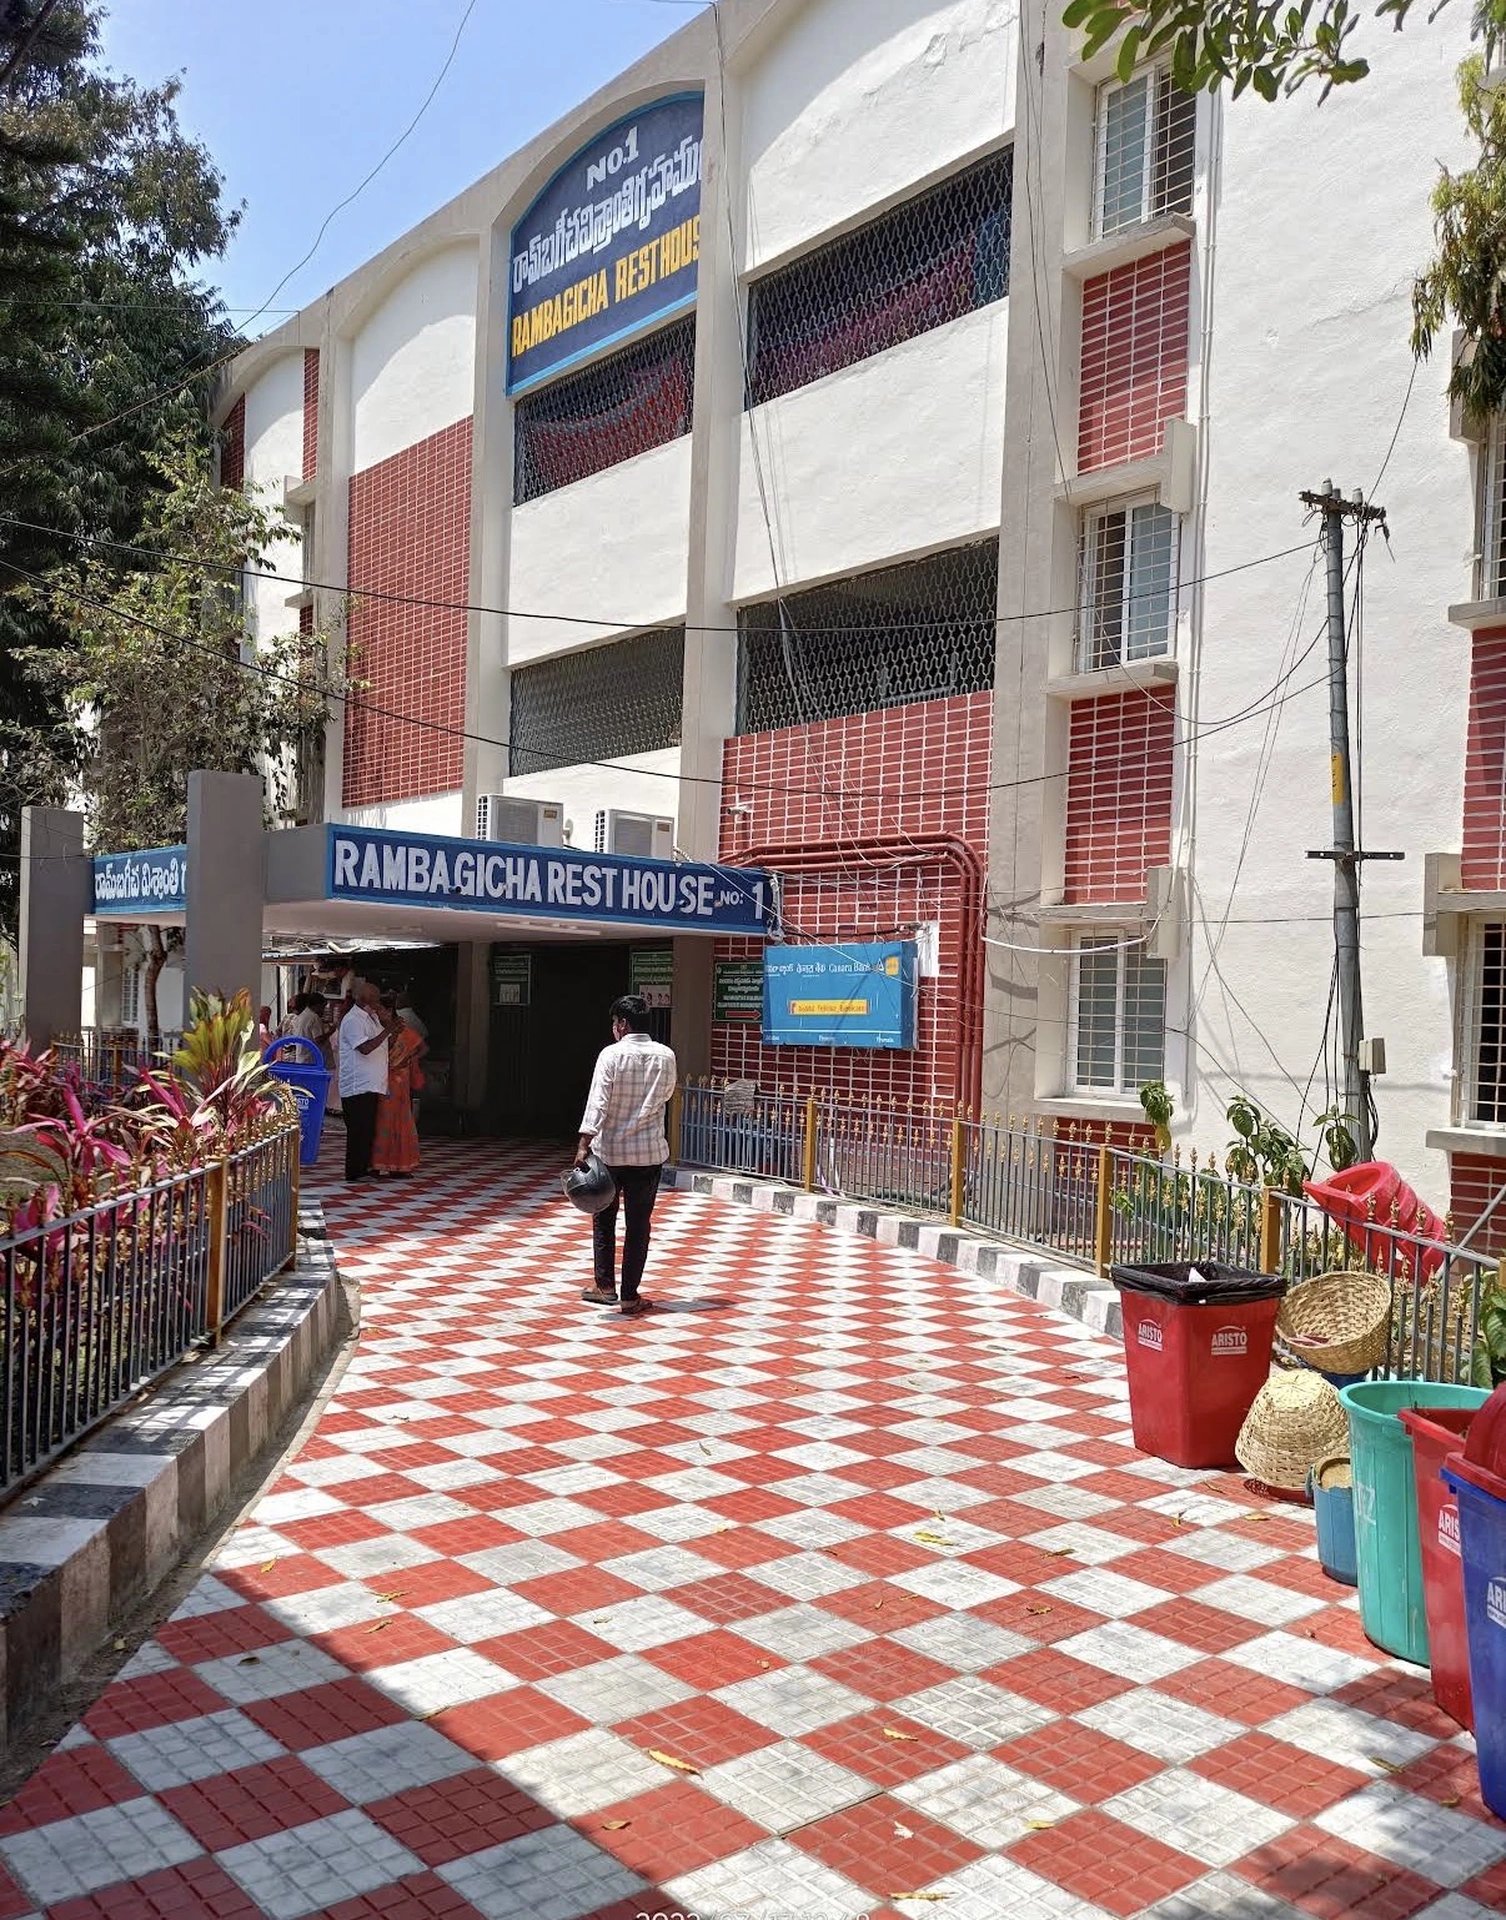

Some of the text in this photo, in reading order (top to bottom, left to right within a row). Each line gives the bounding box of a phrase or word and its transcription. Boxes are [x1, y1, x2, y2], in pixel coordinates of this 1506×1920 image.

[586, 126, 639, 191] NO.1
[511, 268, 608, 358] RAMBAGICHA
[334, 840, 542, 903] RAMBAGICHA
[548, 861, 617, 908] REST
[622, 868, 715, 916] HOUSE
[752, 882, 764, 920] 1
[1138, 1323, 1163, 1343] ARISTO
[1211, 1332, 1248, 1347] ARISTO
